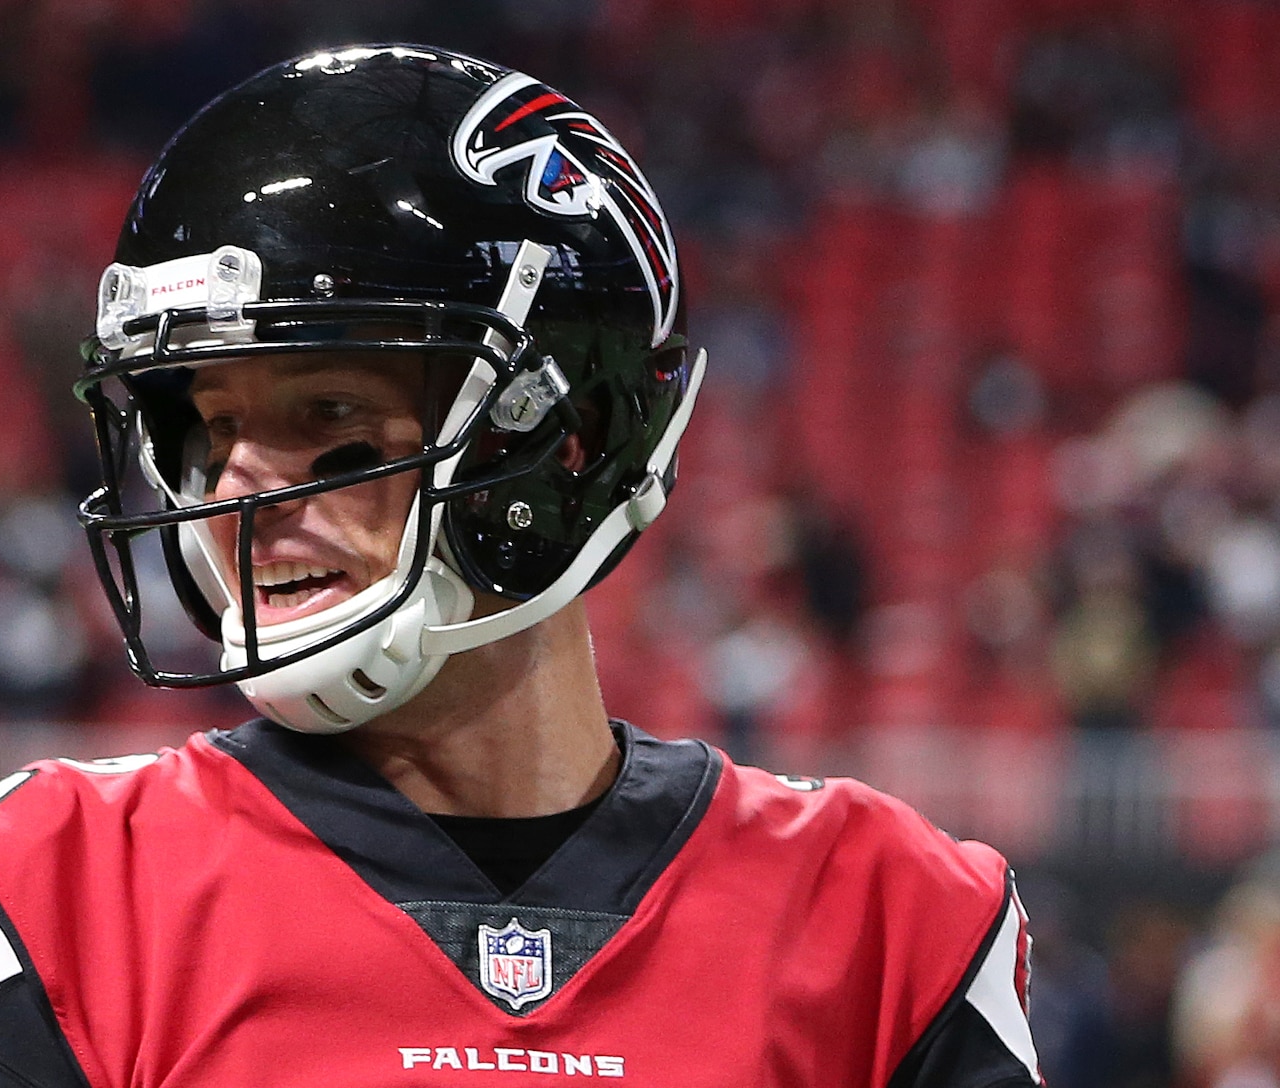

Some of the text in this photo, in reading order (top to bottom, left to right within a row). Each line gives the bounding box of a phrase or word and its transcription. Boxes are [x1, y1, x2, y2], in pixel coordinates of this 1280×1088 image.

[151, 278, 205, 296] FALCON
[492, 957, 540, 989] NFL
[398, 1046, 625, 1078] FALCONS
